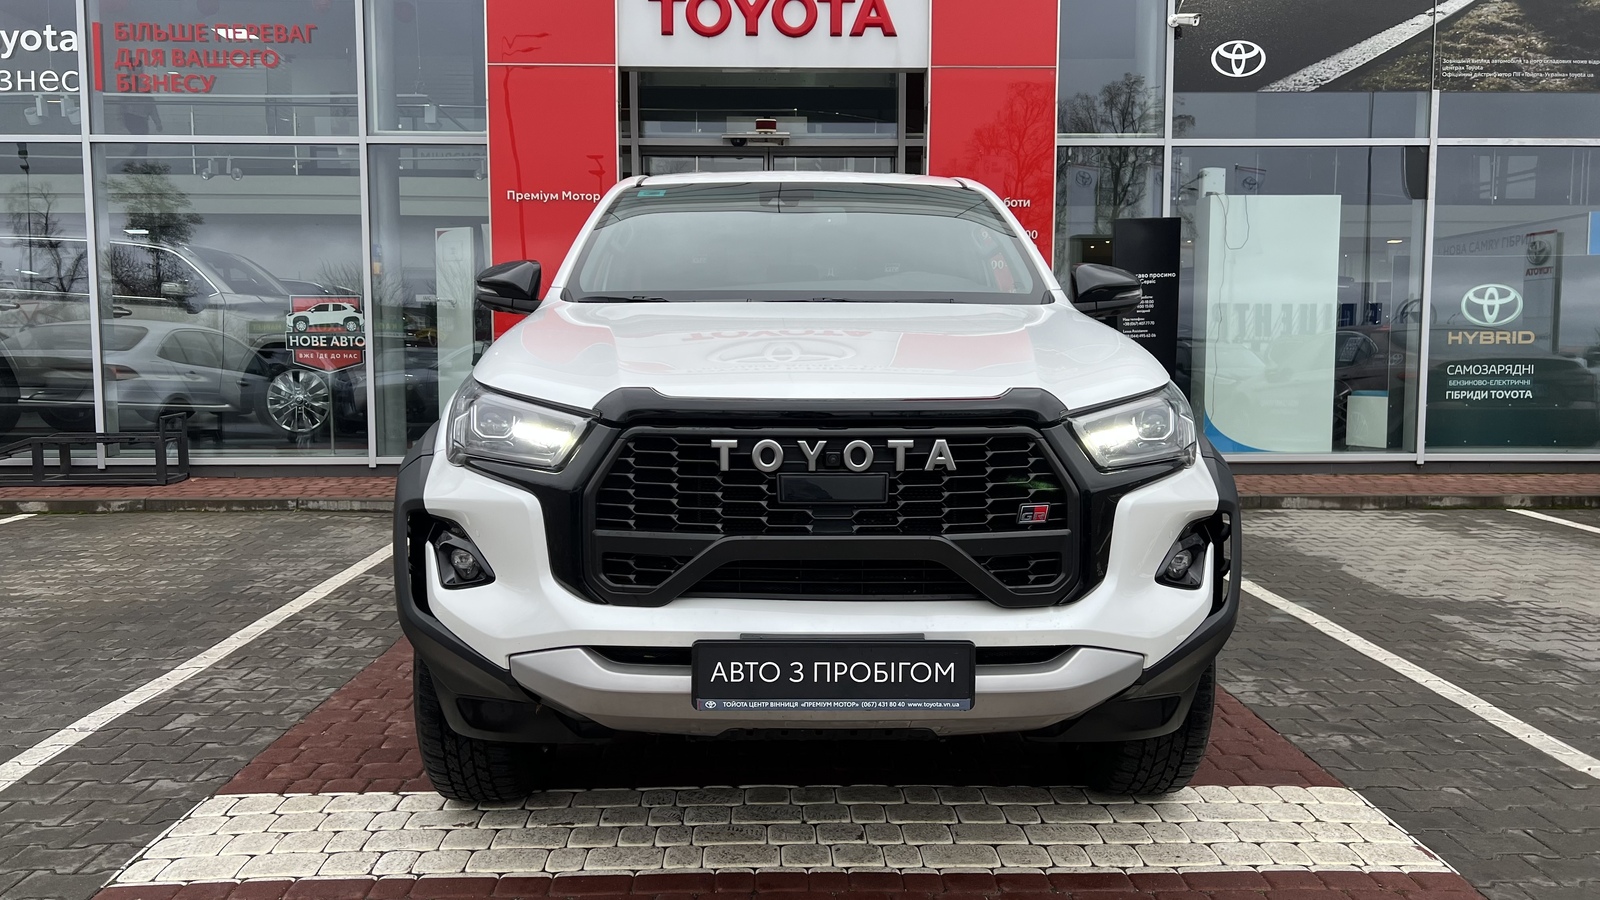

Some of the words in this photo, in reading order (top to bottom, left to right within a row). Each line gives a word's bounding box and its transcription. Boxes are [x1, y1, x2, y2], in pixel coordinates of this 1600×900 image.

[648, 0, 897, 37] TOYOTA
[114, 22, 208, 42] БІЛЬШЕ
[214, 23, 317, 43] ПЕРЕВАГ
[114, 48, 165, 70] ДЛЯ
[171, 49, 279, 69] ВАШОГО
[116, 74, 215, 93] БІЗНЕСУ
[506, 190, 559, 203] Преміум
[561, 190, 601, 203] Мотор
[289, 335, 328, 347] НОВЕ
[330, 335, 366, 347] АВТО
[1447, 330, 1536, 345] HYBRID
[1446, 364, 1534, 376] САМОЗАРЯДНІ
[1448, 379, 1531, 387] БЕНЗИНОВО-ЕЛЕКТРИЧНІ
[1445, 390, 1489, 400] ГІБРИДИ
[1490, 390, 1533, 399] TOYOTA
[710, 438, 957, 473] TOYOTA
[1021, 511, 1046, 521] GR
[709, 661, 781, 683] АВТО
[813, 661, 956, 683] ПРОБІГОМ
[722, 700, 748, 708] ТОЙОТА
[748, 701, 770, 709] ЦЕНТР
[770, 701, 799, 709] ВІННИЦЯ
[907, 701, 960, 709] www.toyota.vn.ua
